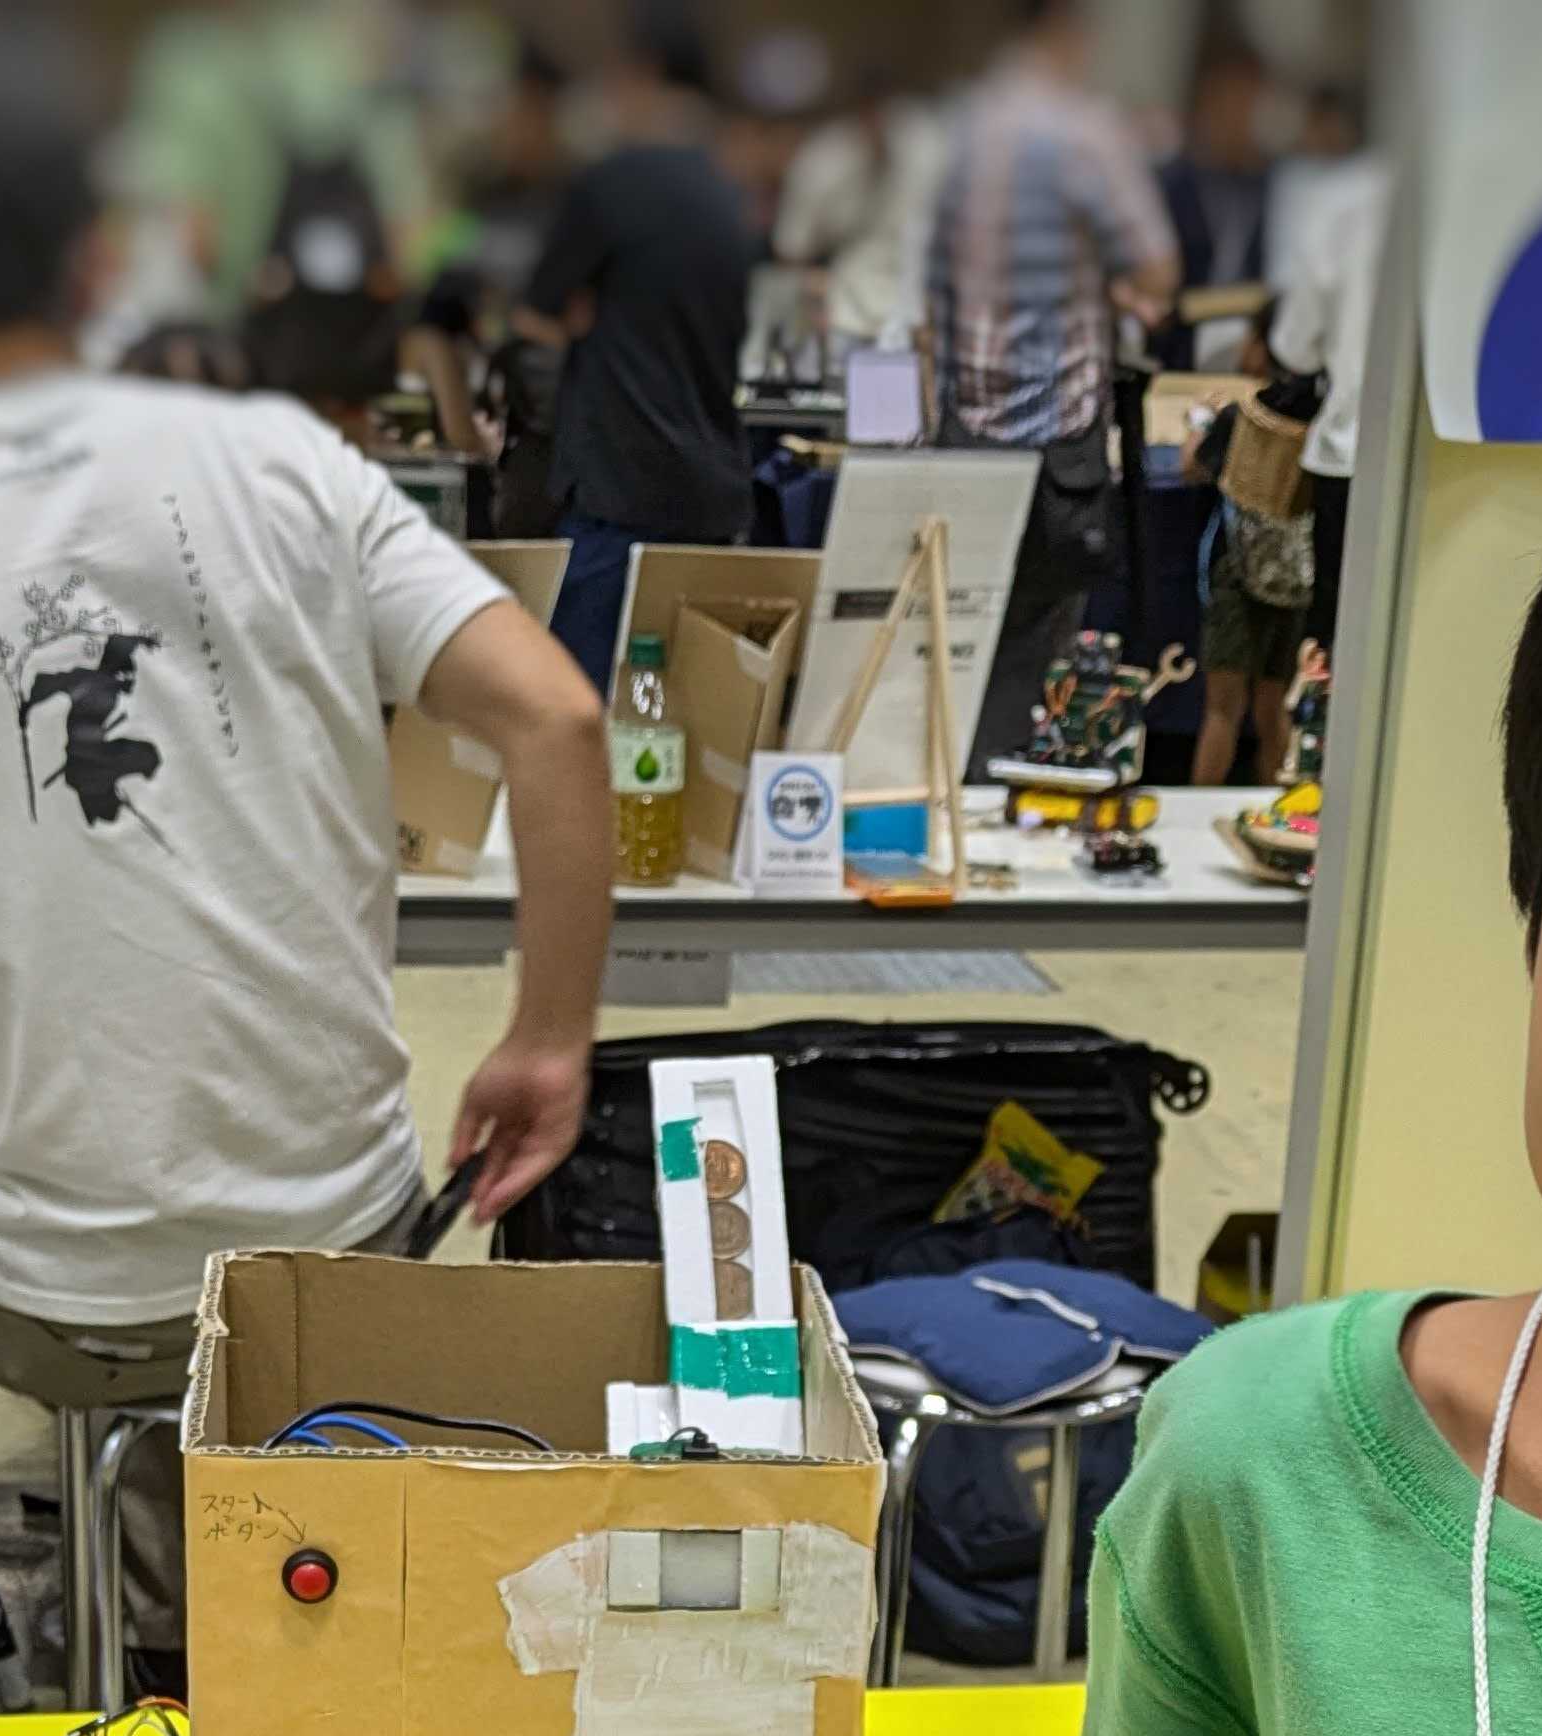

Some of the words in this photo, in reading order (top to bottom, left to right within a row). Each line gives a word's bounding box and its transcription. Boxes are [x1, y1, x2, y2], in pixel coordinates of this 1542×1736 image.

[200, 1491, 273, 1514] スタート
[203, 1515, 279, 1543] ボタン
